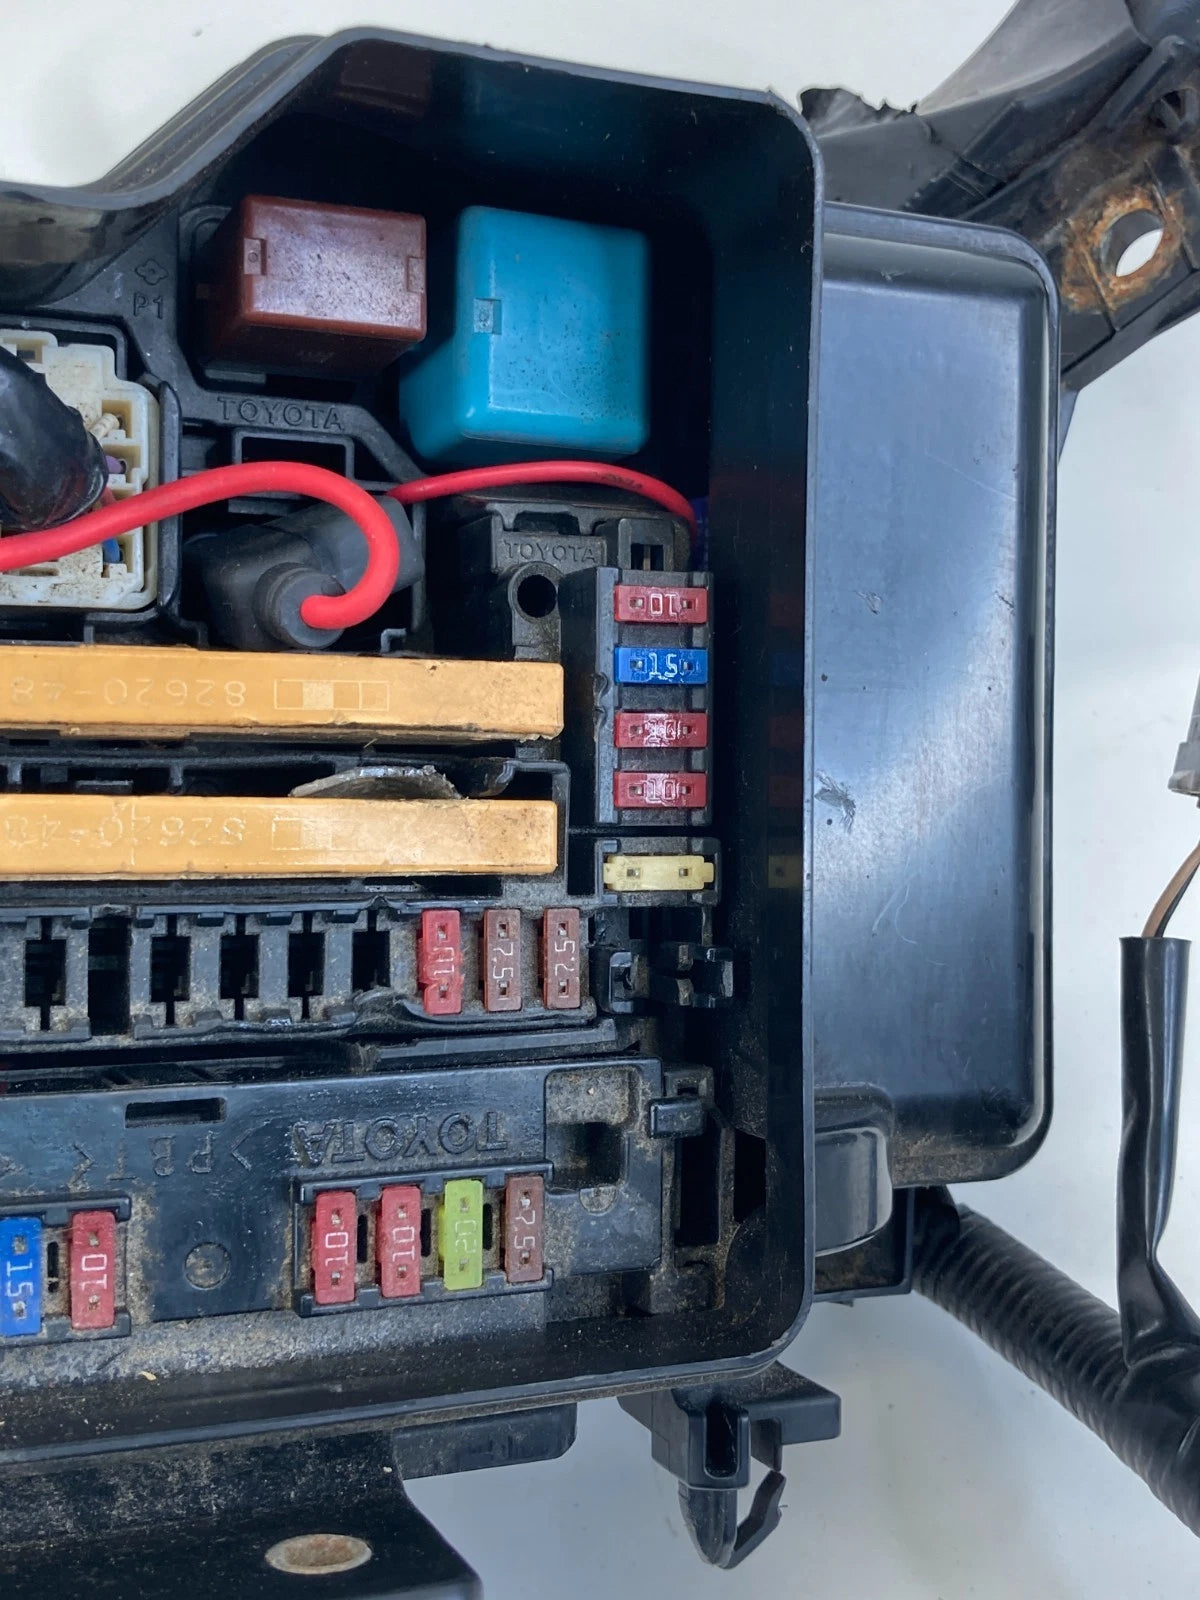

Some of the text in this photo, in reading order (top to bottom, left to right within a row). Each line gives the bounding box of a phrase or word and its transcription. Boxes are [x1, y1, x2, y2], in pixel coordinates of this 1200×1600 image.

[133, 292, 163, 319] P1
[217, 397, 345, 430] TOYOTA
[504, 540, 597, 563] TOYOTA
[649, 593, 678, 619] 10
[648, 651, 678, 679] 15
[648, 778, 675, 802] 10
[493, 943, 514, 979] 7.5
[554, 939, 576, 977] 7.5
[291, 1112, 507, 1167] TOYOTA
[392, 1226, 416, 1262] 10
[514, 1209, 536, 1250] 7.5
[325, 1230, 349, 1267] 10
[7, 1260, 34, 1298] 15
[81, 1253, 108, 1291] 10
